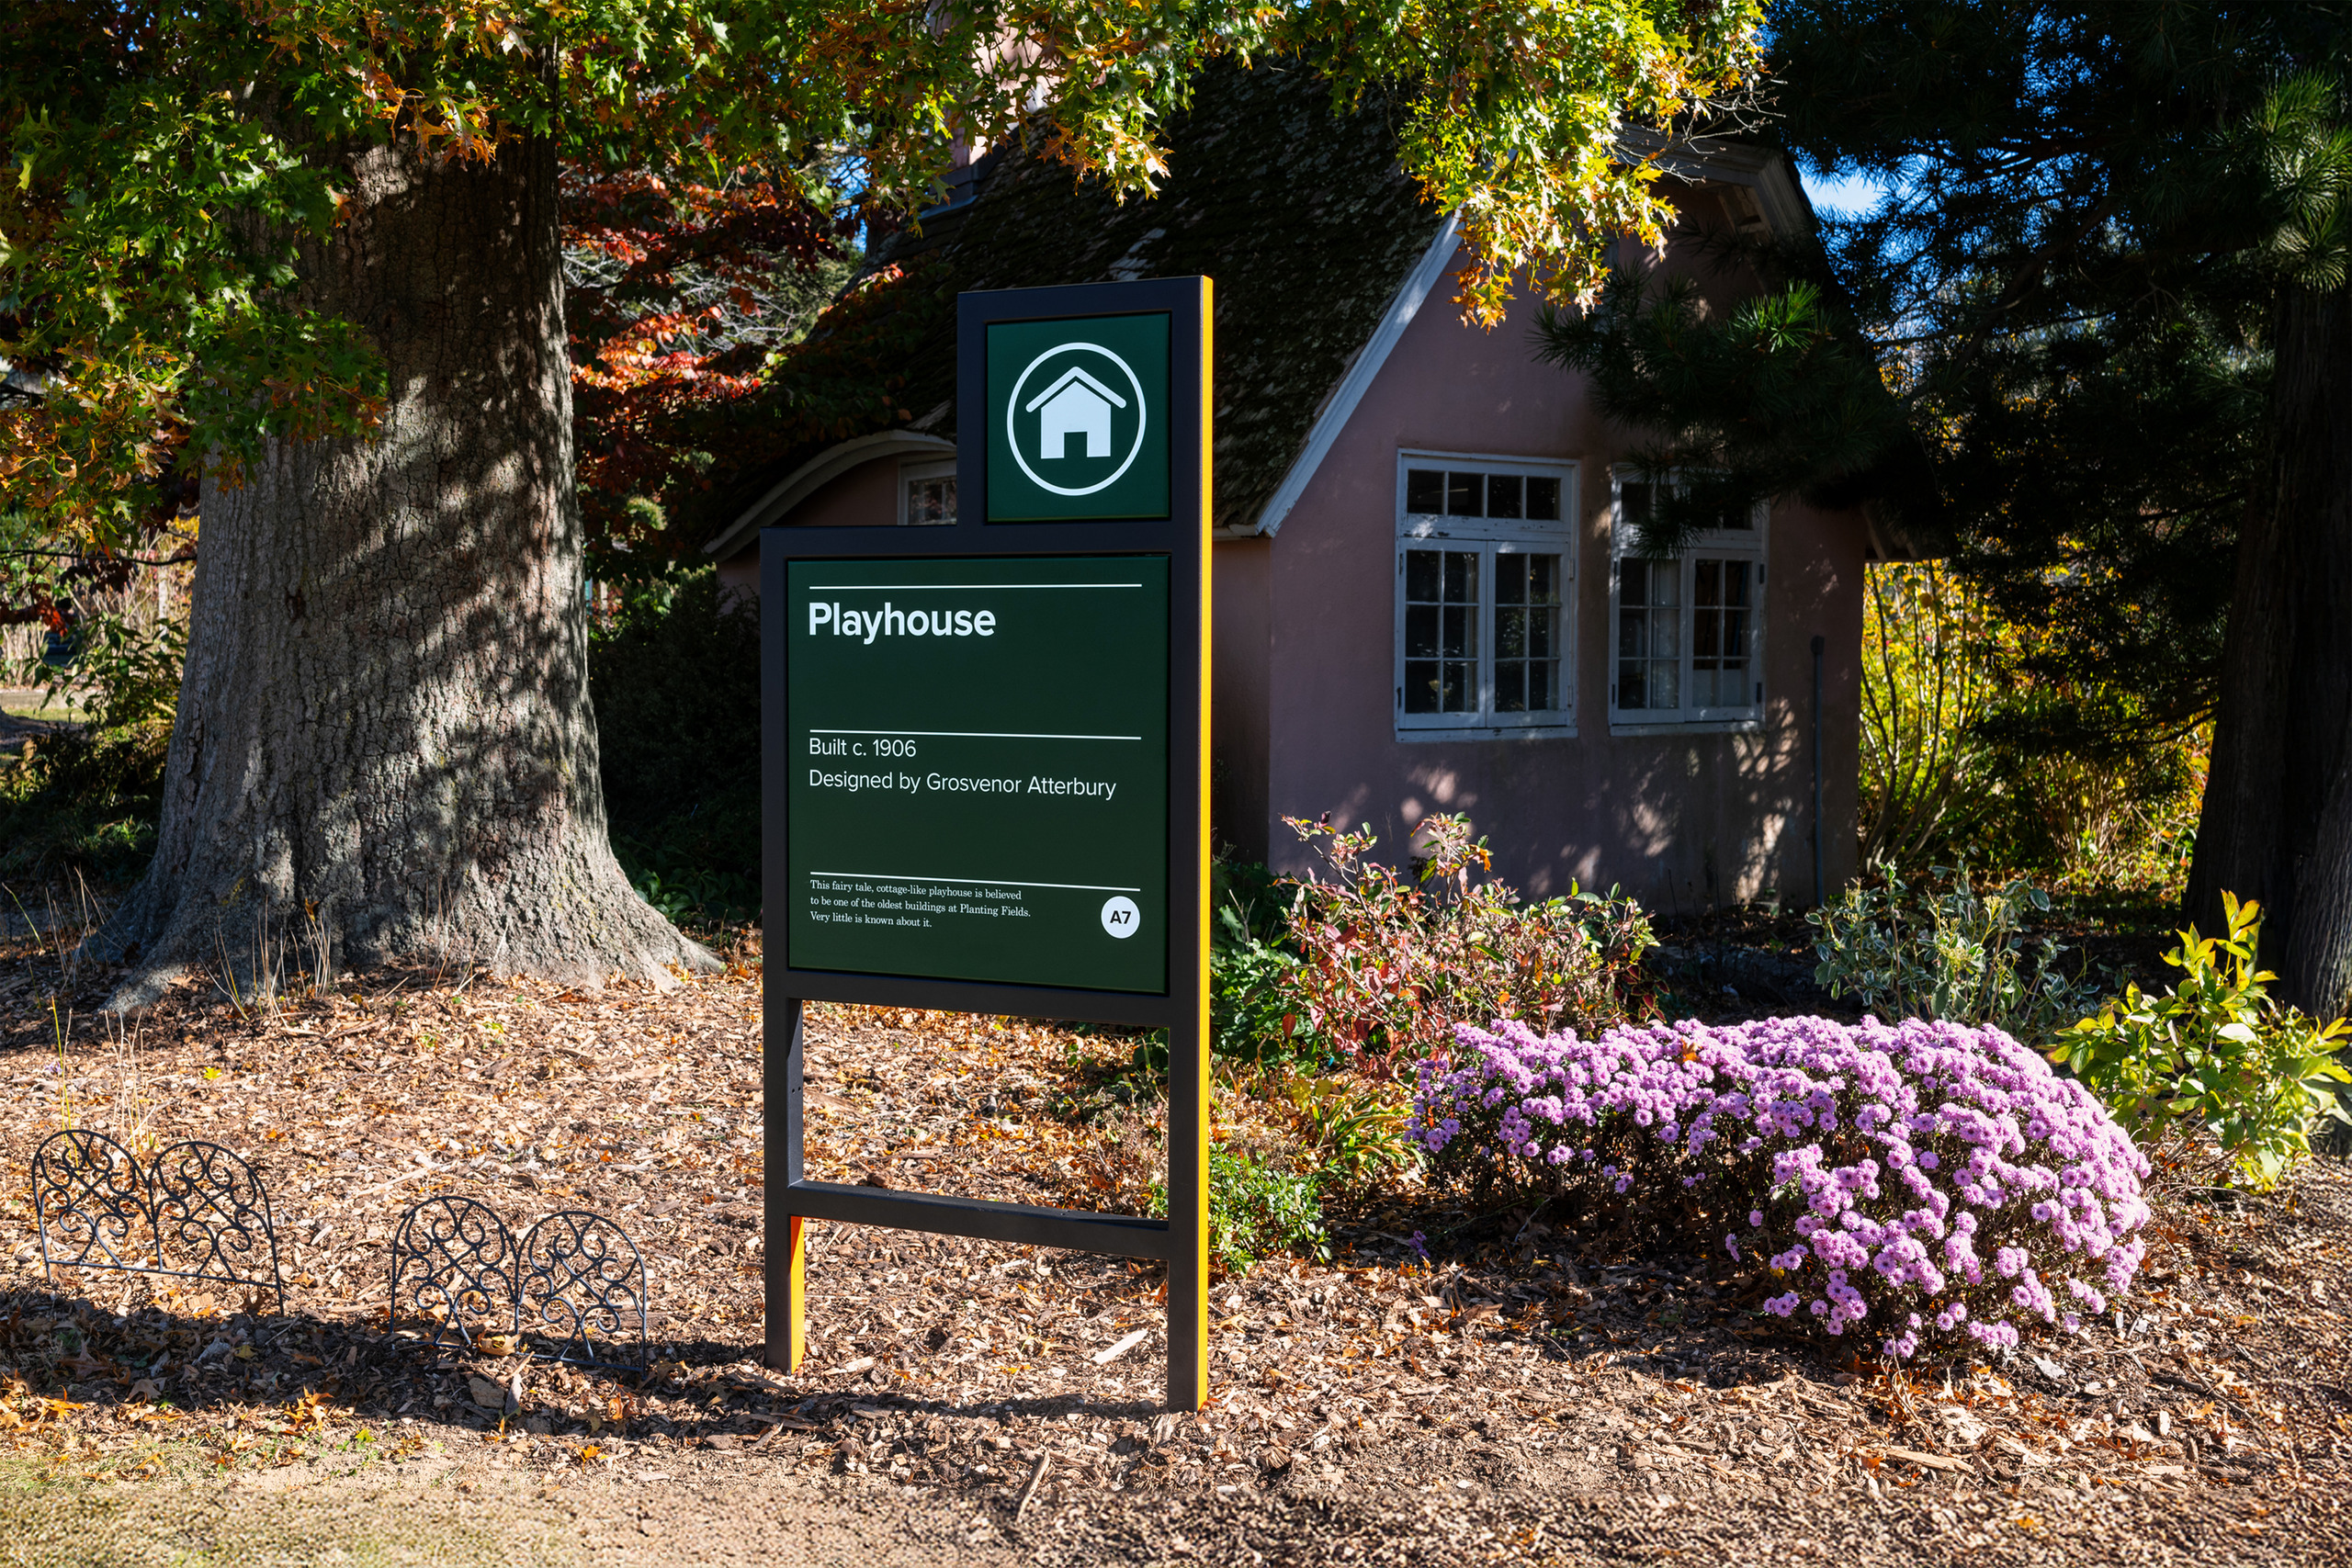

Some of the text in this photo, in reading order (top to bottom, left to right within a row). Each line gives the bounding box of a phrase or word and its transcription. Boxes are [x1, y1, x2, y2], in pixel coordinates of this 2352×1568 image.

[809, 603, 996, 645] Playhouse
[810, 738, 916, 757] Built c. 1906
[810, 770, 1116, 800] Designed by Grosvenor Atterbury
[809, 879, 1023, 900] This fairy tale, cottage-like playhouse is believed
[809, 896, 1031, 918] to be one of the oldest buildings at Planting Fields.
[1109, 909, 1133, 925] A7
[809, 910, 933, 928] Very little is known about it.
